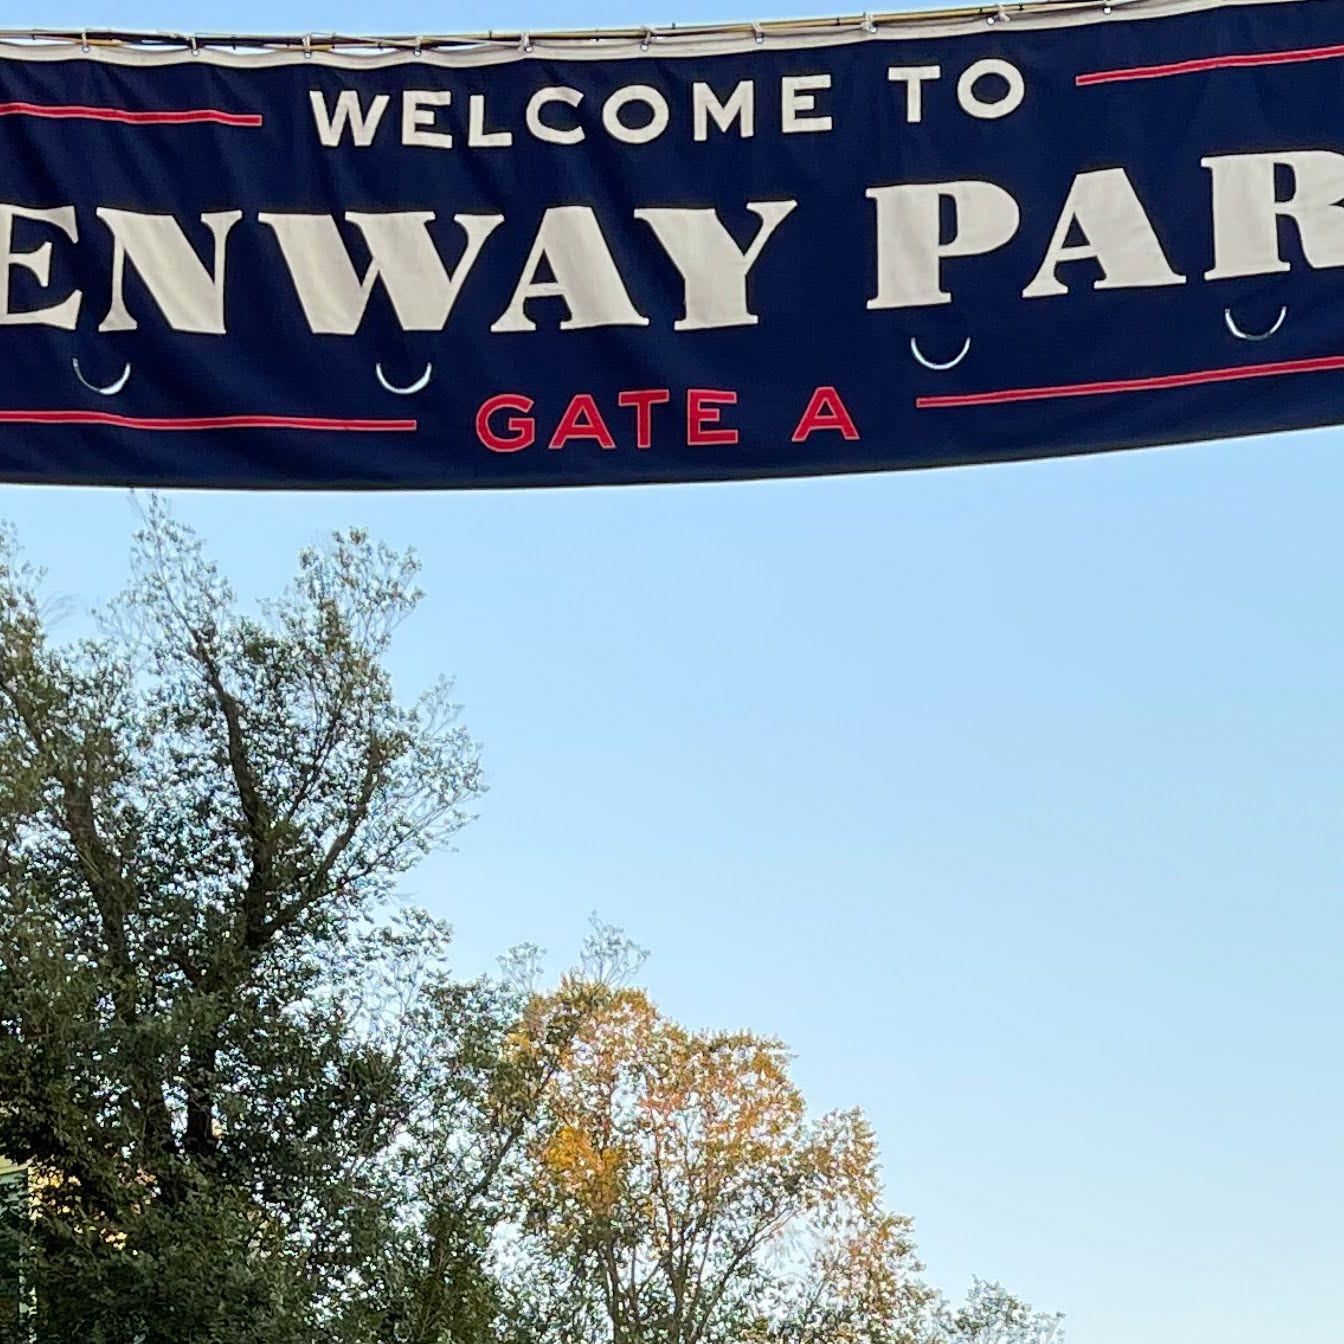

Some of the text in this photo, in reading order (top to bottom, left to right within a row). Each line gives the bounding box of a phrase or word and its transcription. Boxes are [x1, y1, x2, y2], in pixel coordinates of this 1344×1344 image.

[309, 58, 1025, 150] WELCOME TO
[476, 385, 860, 453] GATE A
